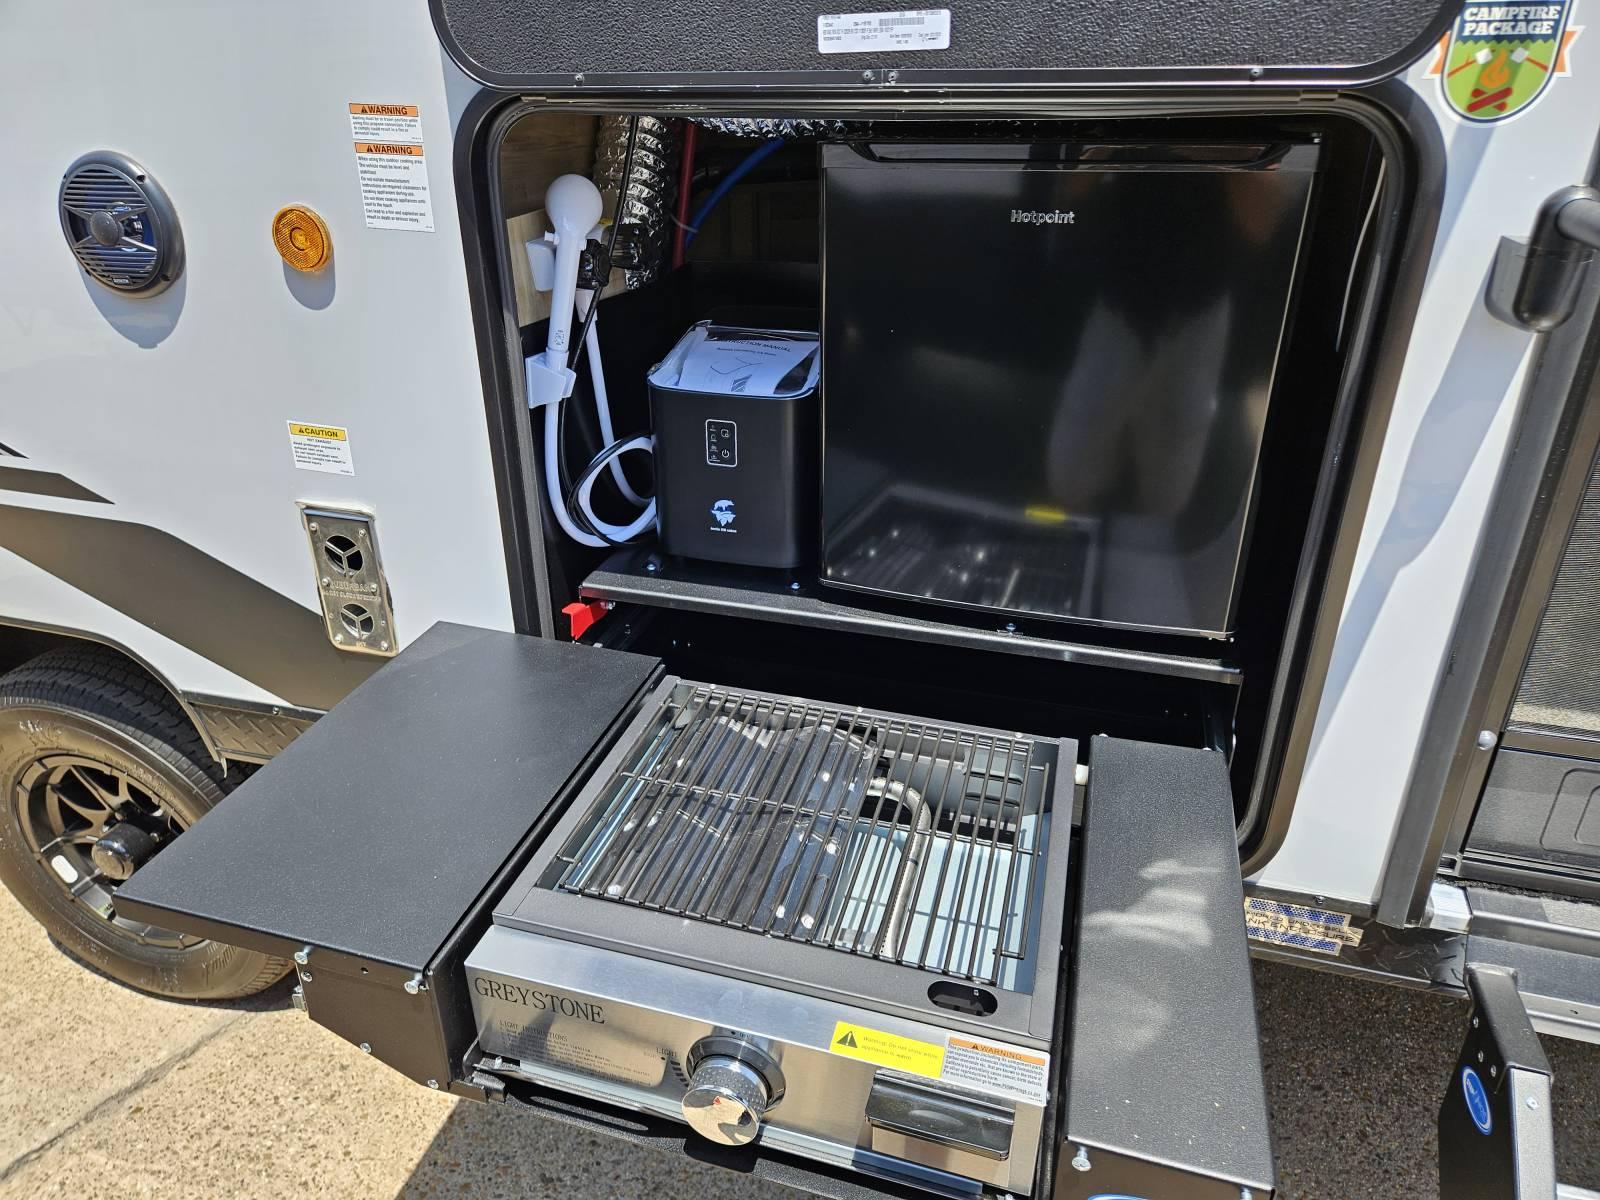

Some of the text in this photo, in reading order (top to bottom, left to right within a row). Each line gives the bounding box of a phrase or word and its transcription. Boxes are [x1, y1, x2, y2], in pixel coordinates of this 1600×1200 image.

[1464, 5, 1561, 20] CAMPFIRE
[1462, 21, 1554, 36] PACKAGE
[368, 106, 408, 115] WARNING
[374, 145, 413, 154] WARNING
[1010, 209, 1075, 226] Hotpoint
[304, 428, 338, 438] CAUTION
[474, 977, 605, 1024] GREYSTONE
[981, 1045, 1022, 1060] WARNING
